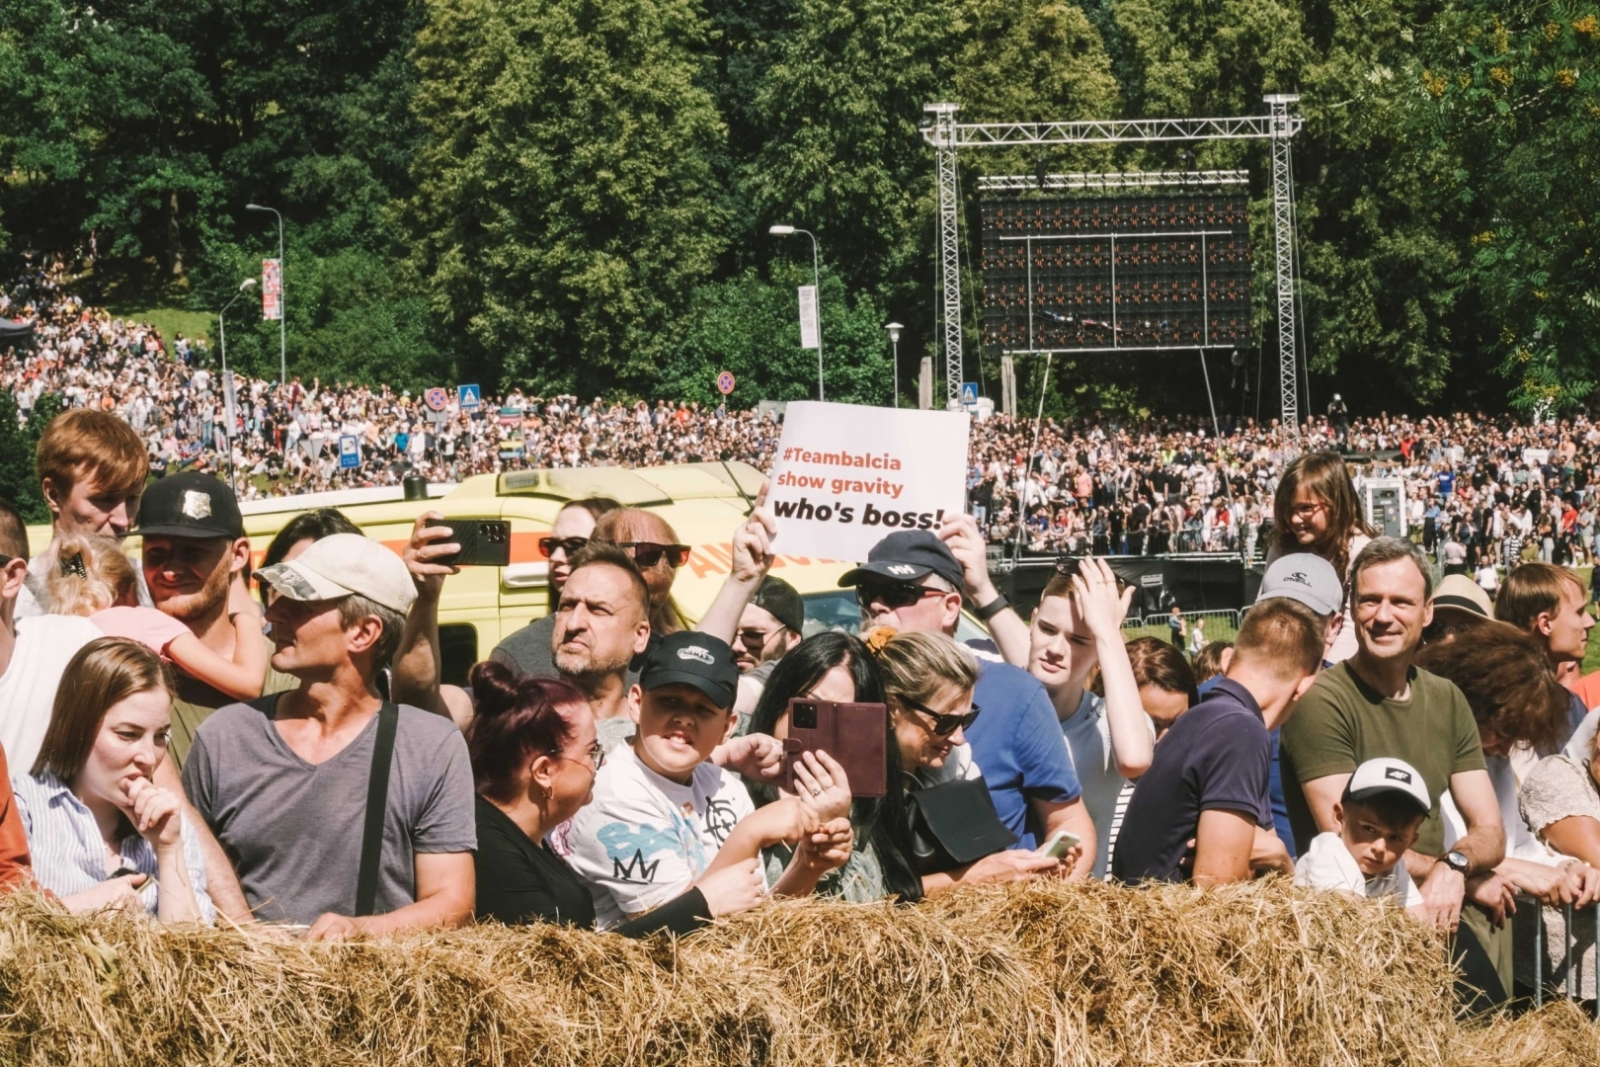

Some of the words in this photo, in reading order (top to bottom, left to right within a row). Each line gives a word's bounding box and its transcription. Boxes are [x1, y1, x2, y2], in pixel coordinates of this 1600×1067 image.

[783, 447, 902, 470] #Teambalcia
[777, 471, 825, 488] show
[831, 478, 904, 498] gravity
[774, 497, 854, 523] who's
[862, 503, 945, 530] boss!
[887, 564, 916, 575] HH
